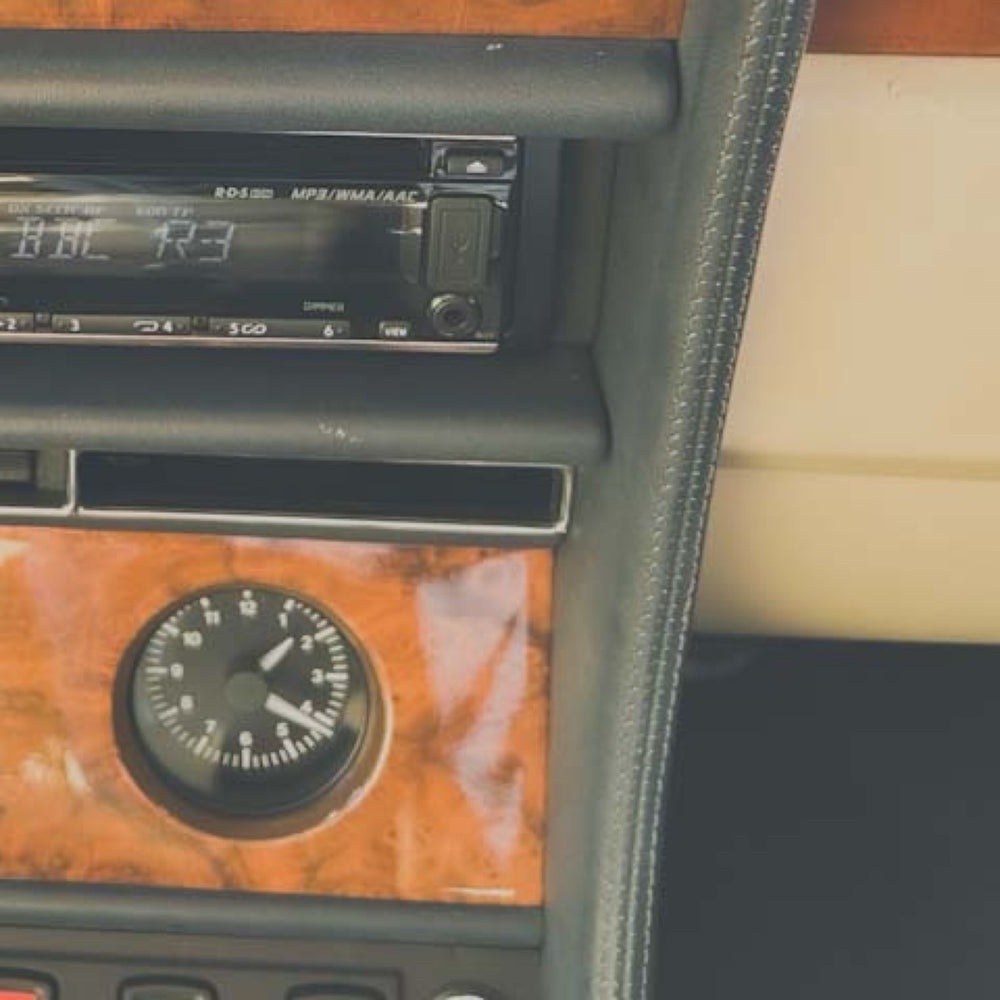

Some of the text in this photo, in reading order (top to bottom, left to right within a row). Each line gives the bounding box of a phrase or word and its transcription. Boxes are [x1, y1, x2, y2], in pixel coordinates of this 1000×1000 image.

[162, 320, 174, 333] 4
[323, 324, 335, 338] 6
[182, 630, 203, 647] 10
[300, 634, 314, 651] 2
[311, 668, 325, 685] 3
[204, 719, 218, 734] 7
